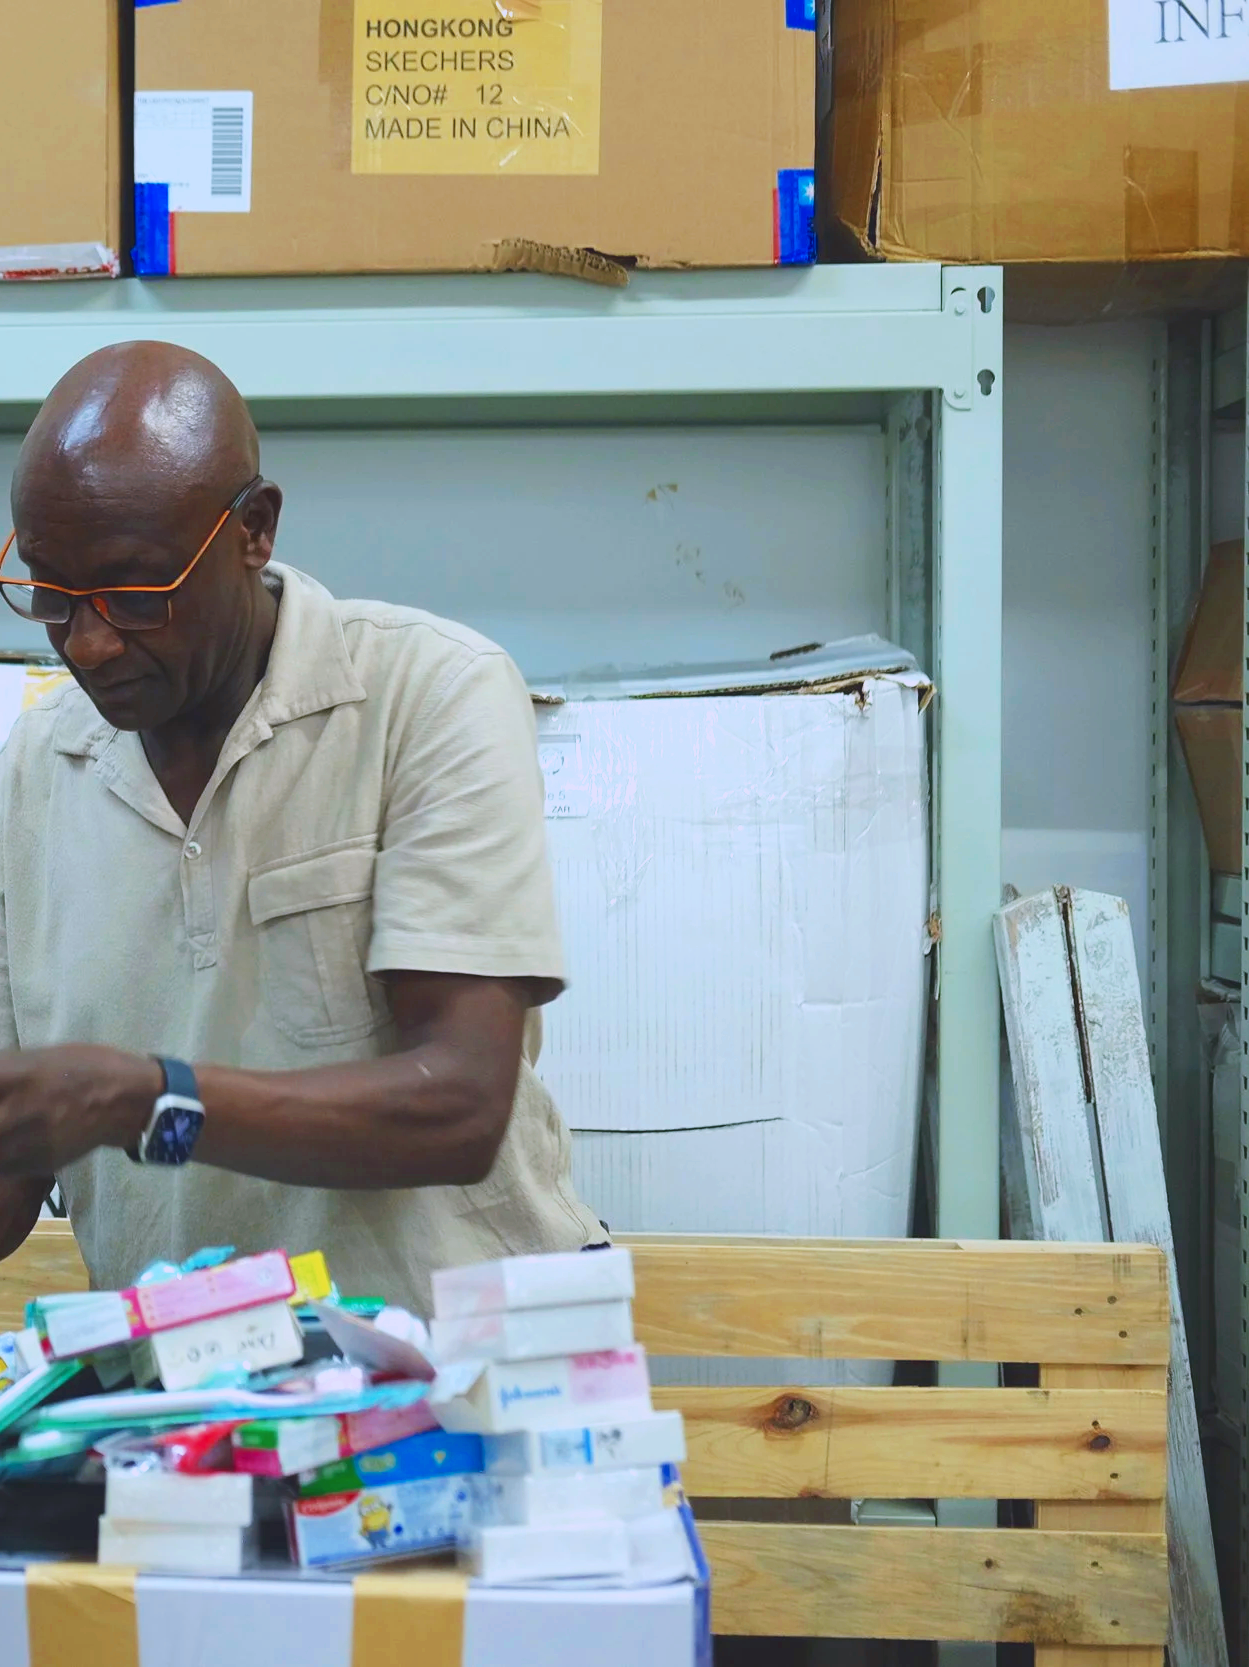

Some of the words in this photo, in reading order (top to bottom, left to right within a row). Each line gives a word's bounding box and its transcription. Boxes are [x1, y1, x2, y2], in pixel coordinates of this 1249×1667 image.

[366, 18, 513, 38] HONGKONG
[1155, 0, 1246, 44] INF
[365, 50, 514, 72] SKECHERS
[365, 84, 447, 107] C/NO#
[476, 84, 503, 105] 12
[365, 117, 441, 139] MADE
[452, 118, 477, 138] IN
[486, 117, 570, 139] CHINA
